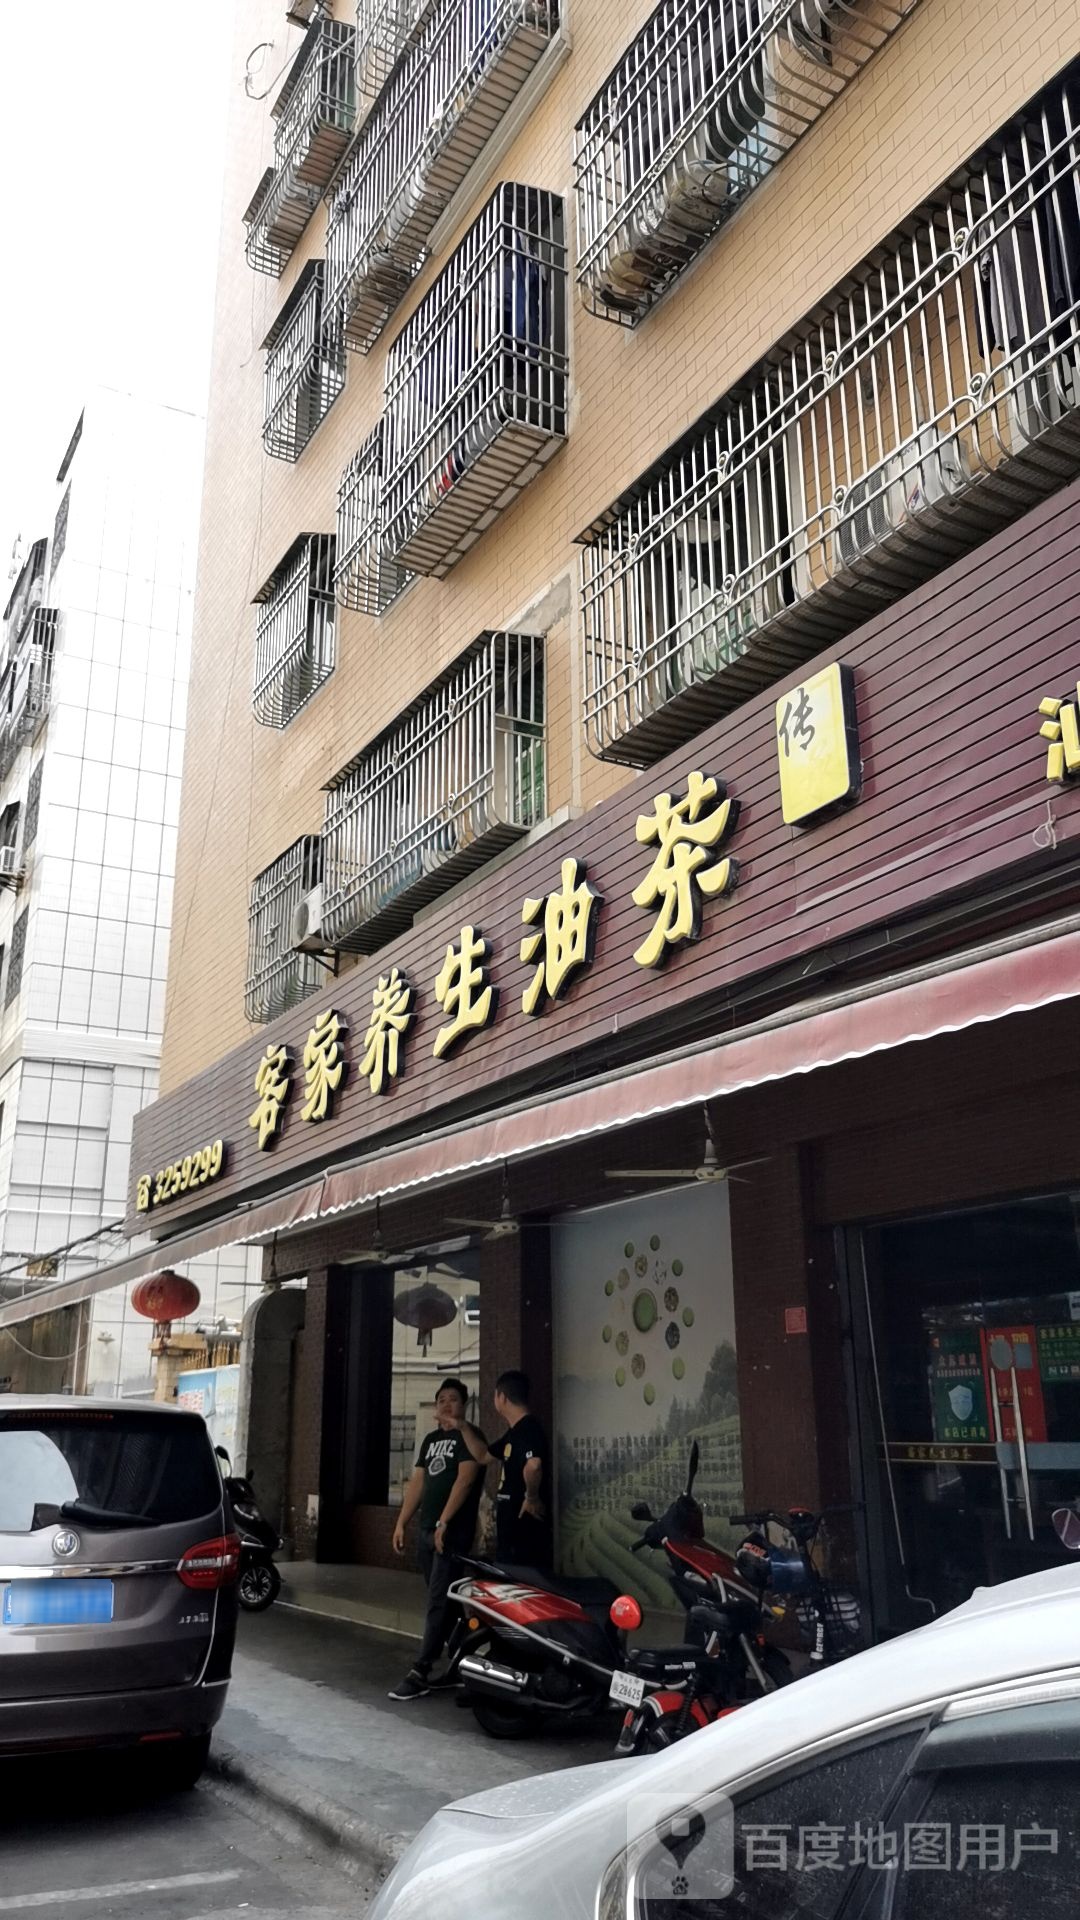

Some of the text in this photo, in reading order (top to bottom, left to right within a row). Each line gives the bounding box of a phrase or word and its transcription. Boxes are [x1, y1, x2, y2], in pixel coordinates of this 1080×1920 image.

[249, 771, 734, 1151] 客家养生油茶
[153, 1139, 224, 1204] 3259299
[425, 1440, 457, 1460] NIKE
